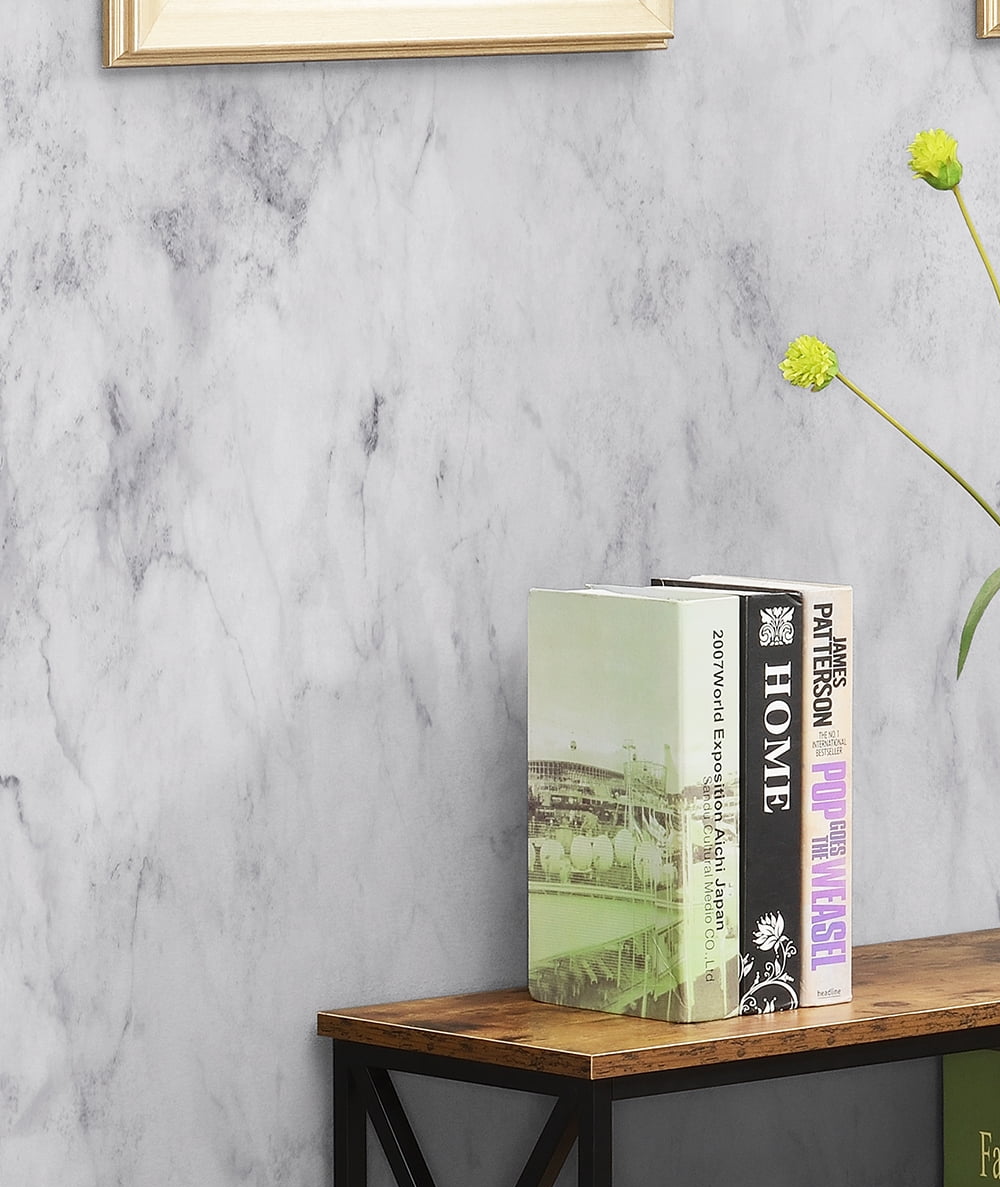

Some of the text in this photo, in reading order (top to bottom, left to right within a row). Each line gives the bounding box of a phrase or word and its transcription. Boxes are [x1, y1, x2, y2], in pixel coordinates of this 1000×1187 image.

[812, 602, 833, 727] PATTERSON
[833, 637, 847, 689] JAMES
[763, 660, 792, 814] HOME
[812, 738, 847, 748] INTERNATIONAL
[815, 746, 843, 757] BESTSELLER
[702, 776, 713, 820] Sandu
[711, 728, 725, 822] Exposition
[812, 760, 847, 820] POP
[703, 824, 714, 878] Cultural
[713, 828, 726, 873] Aichi
[811, 835, 829, 861] THE
[829, 819, 846, 857] GOES
[703, 881, 715, 924] Medio
[713, 878, 726, 931] Japan
[811, 857, 847, 971] WEASEL
[816, 987, 841, 996] headline
